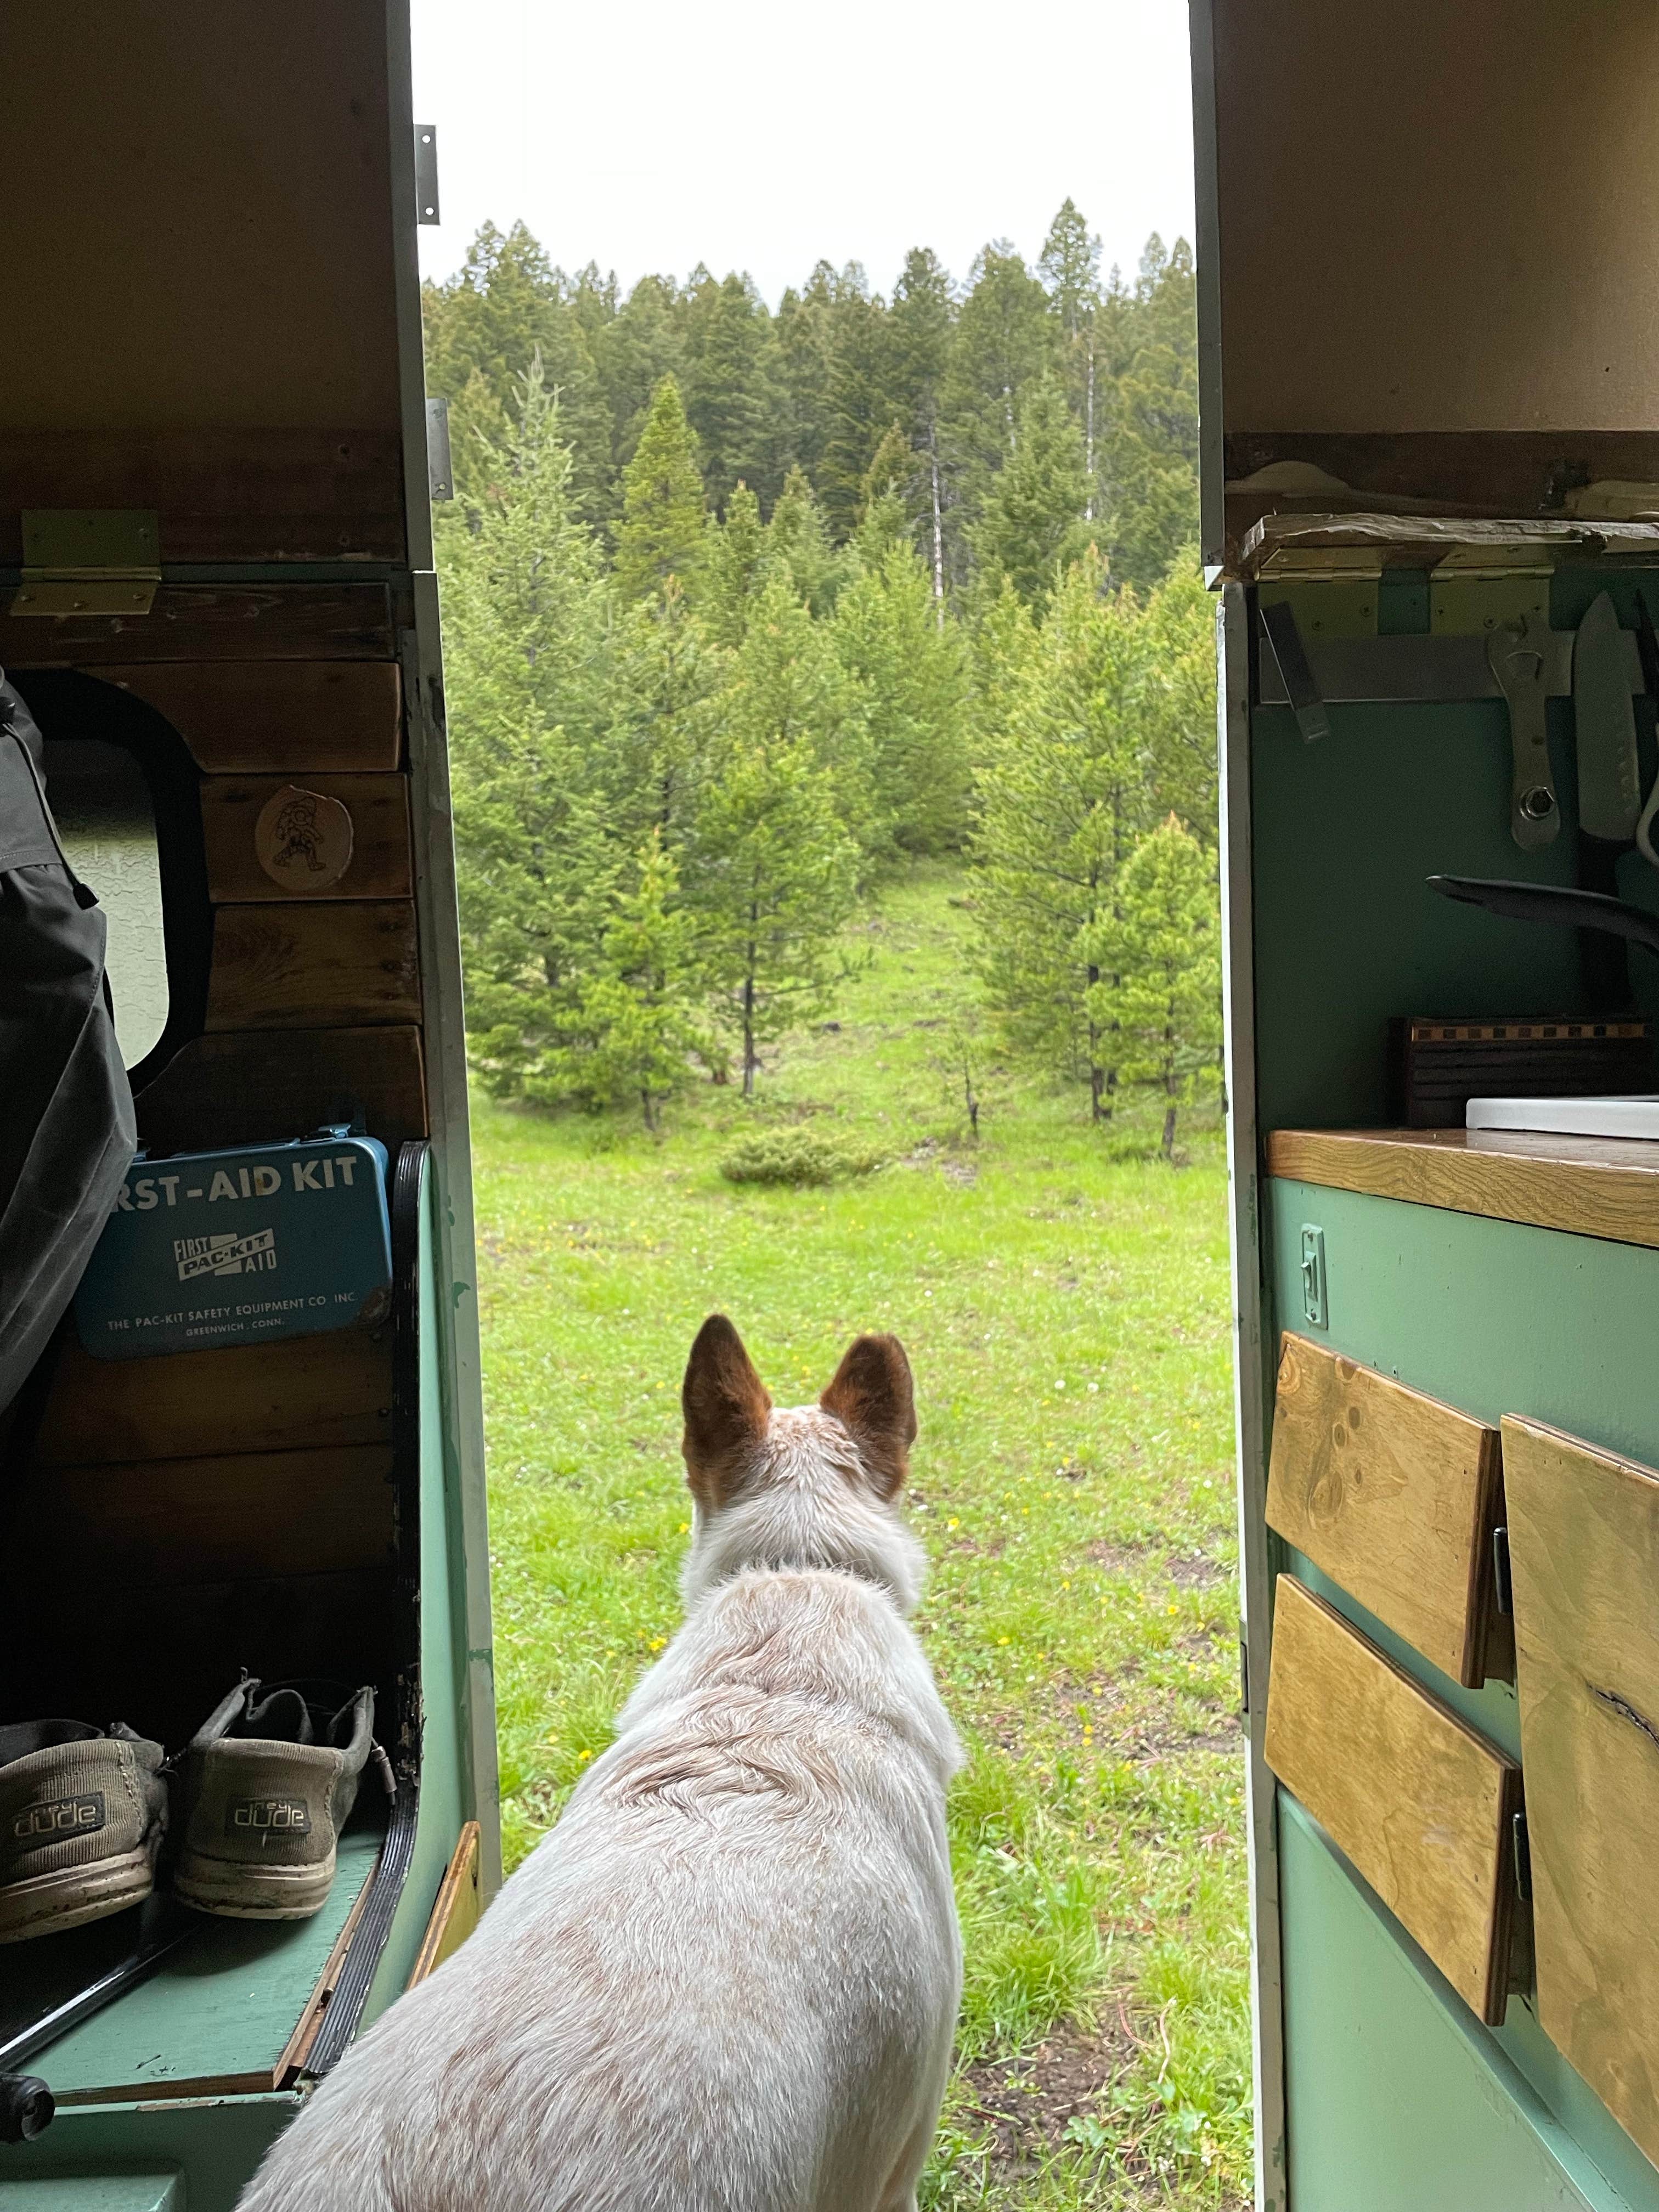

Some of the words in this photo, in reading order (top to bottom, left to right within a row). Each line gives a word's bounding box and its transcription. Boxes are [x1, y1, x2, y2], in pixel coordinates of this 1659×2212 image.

[111, 1166, 281, 1212] RST-AID
[292, 1155, 357, 1192] KIT
[173, 1237, 208, 1262] FIRST
[245, 1249, 277, 1273] AID
[107, 1319, 131, 1331] THE
[136, 1312, 184, 1327] PAC-KIT
[188, 1307, 231, 1321] SAFETY
[236, 1299, 303, 1315] EQUIPMENT
[15, 1801, 96, 1837] dude
[235, 1803, 304, 1827] dude
